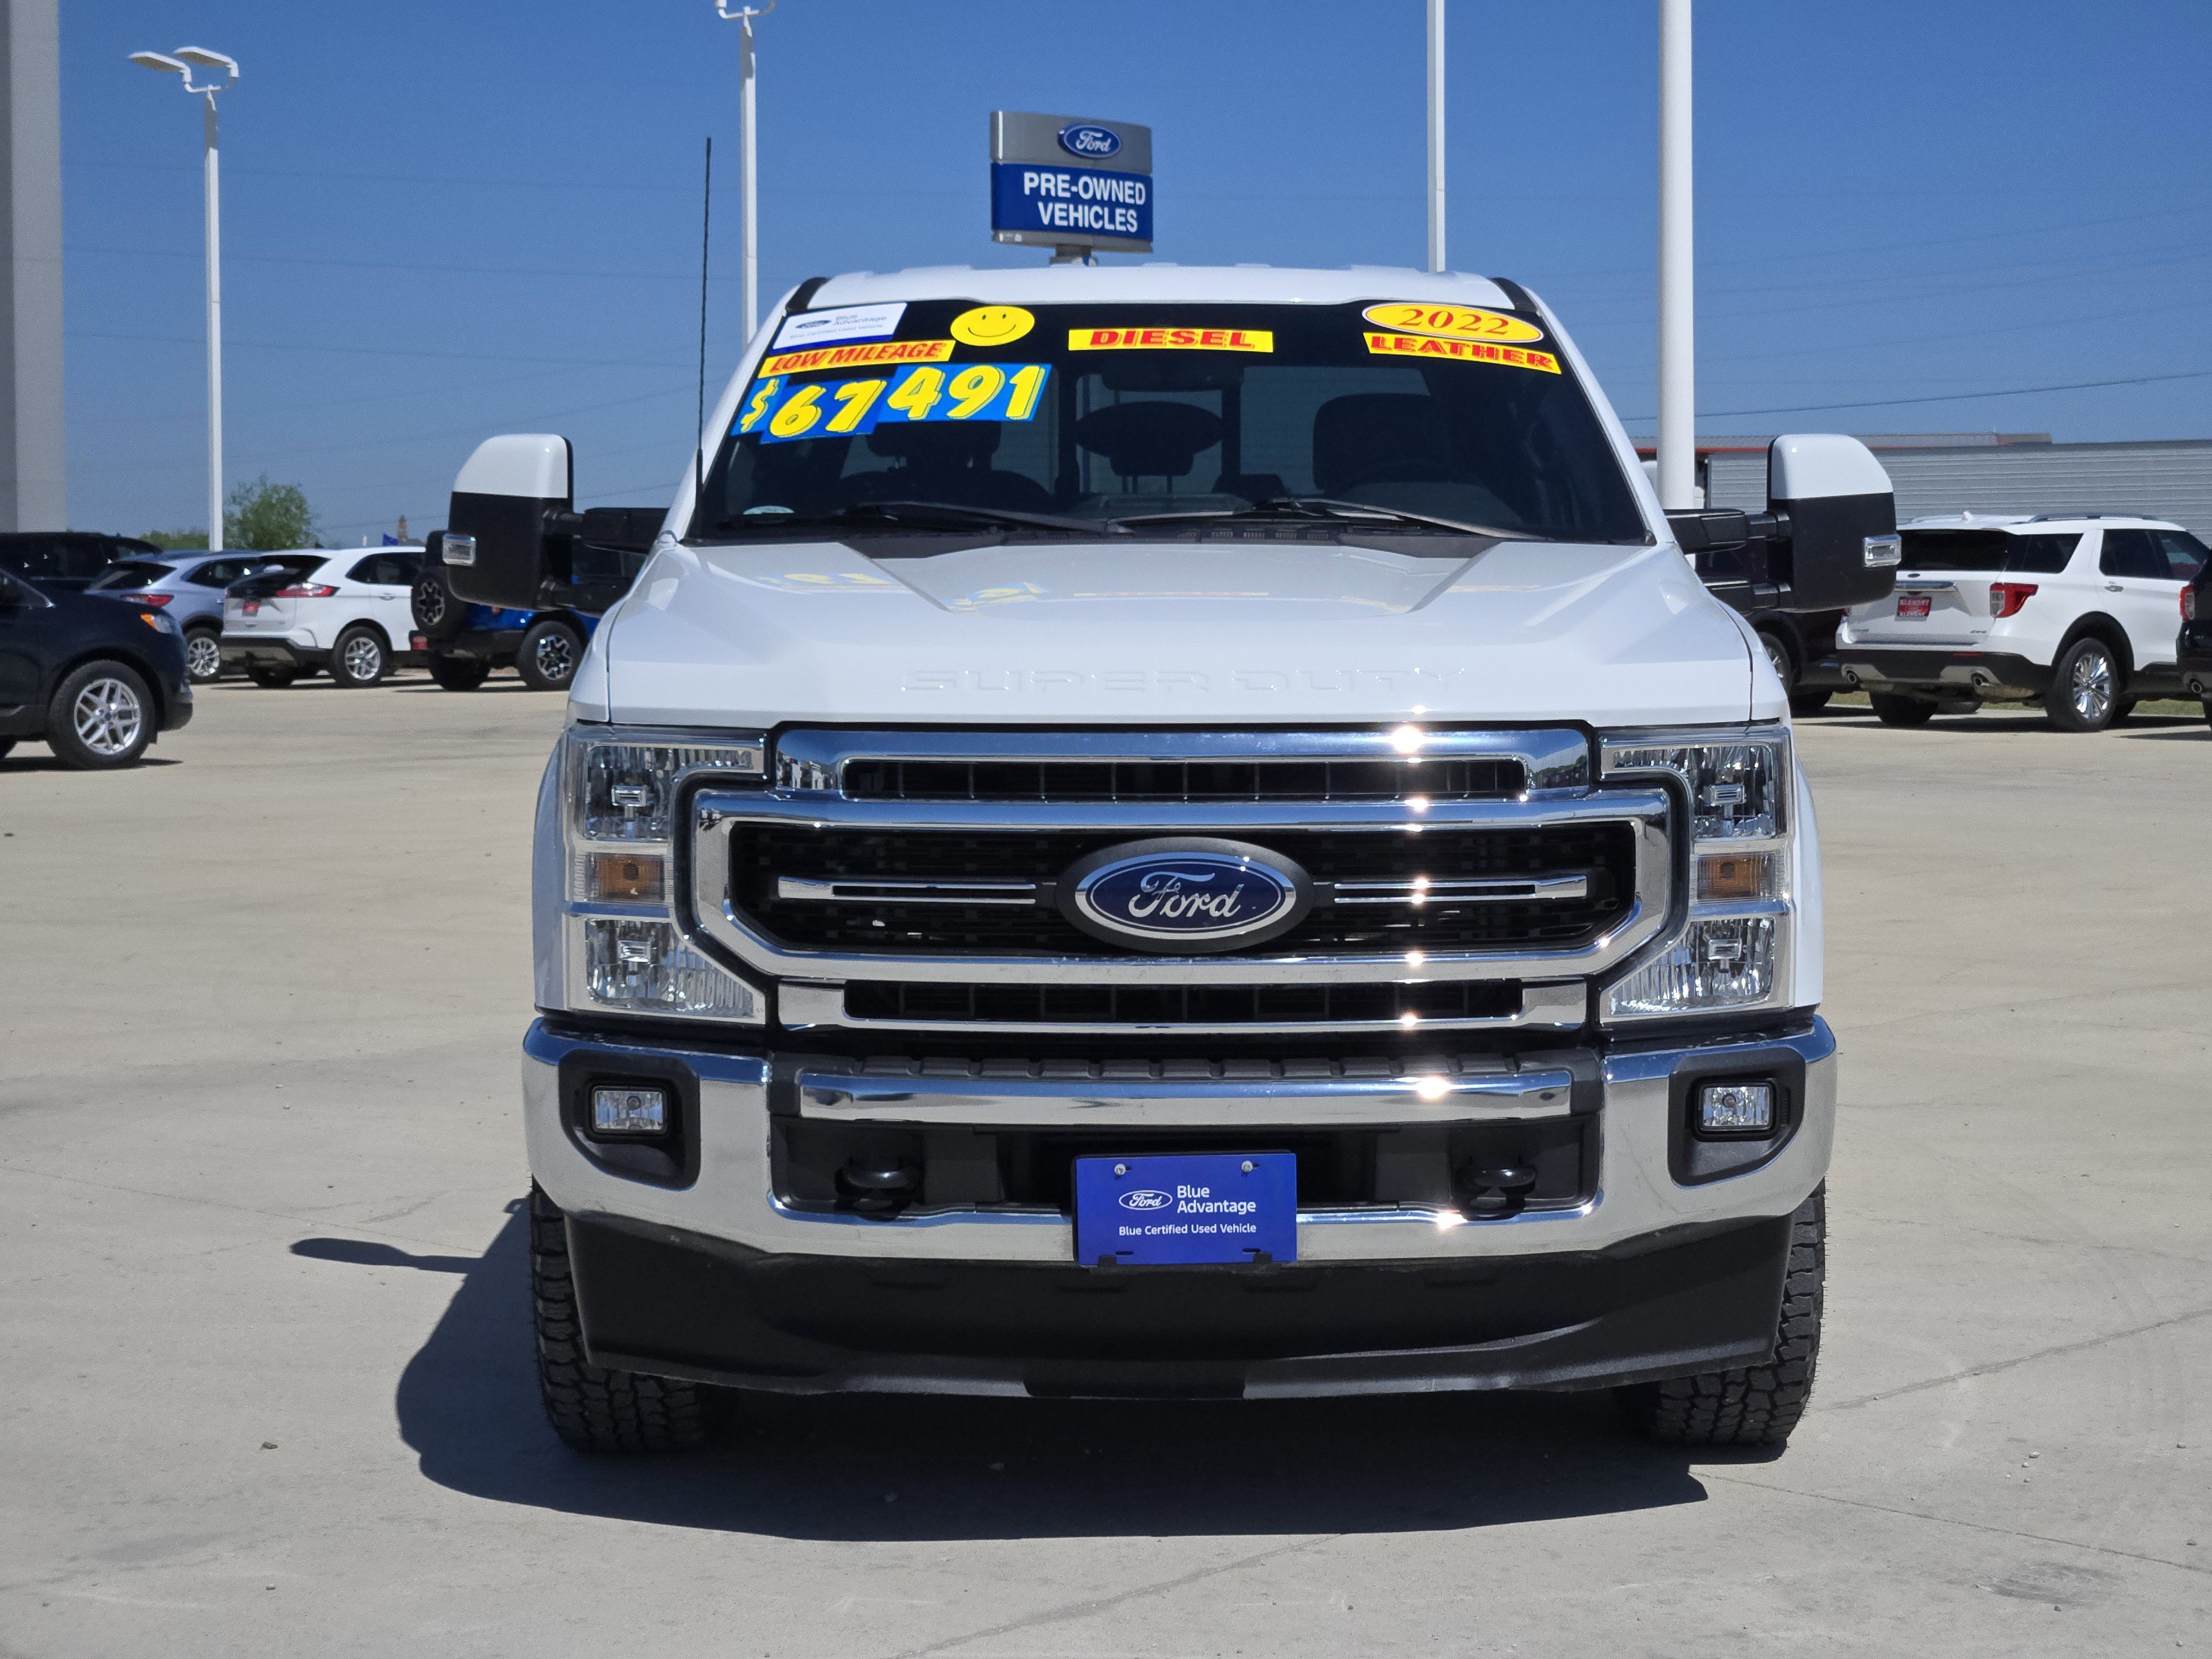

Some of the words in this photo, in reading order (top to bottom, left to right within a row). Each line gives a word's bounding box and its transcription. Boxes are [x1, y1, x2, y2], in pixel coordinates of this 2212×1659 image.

[1075, 129, 1112, 153] Ford
[1024, 171, 1146, 205] PRE-OWNED
[1037, 201, 1138, 233] VEHICLES
[1397, 309, 1509, 335] 2022
[1089, 330, 1255, 348] DIESEL
[769, 351, 832, 373] LOW
[827, 342, 947, 366] MILEAGE
[1370, 336, 1554, 371] LEATHER
[901, 669, 1210, 693] SUPER
[1232, 667, 1465, 692] DUTY
[1128, 871, 1244, 918] Ford
[1129, 1193, 1162, 1208] Ford
[1177, 1185, 1210, 1198] Blue
[1177, 1199, 1256, 1215] Advantage
[1119, 1225, 1142, 1236] Blue
[1144, 1224, 1188, 1235] Certified
[1191, 1224, 1217, 1234] Used
[1219, 1223, 1256, 1234] Vehicle
